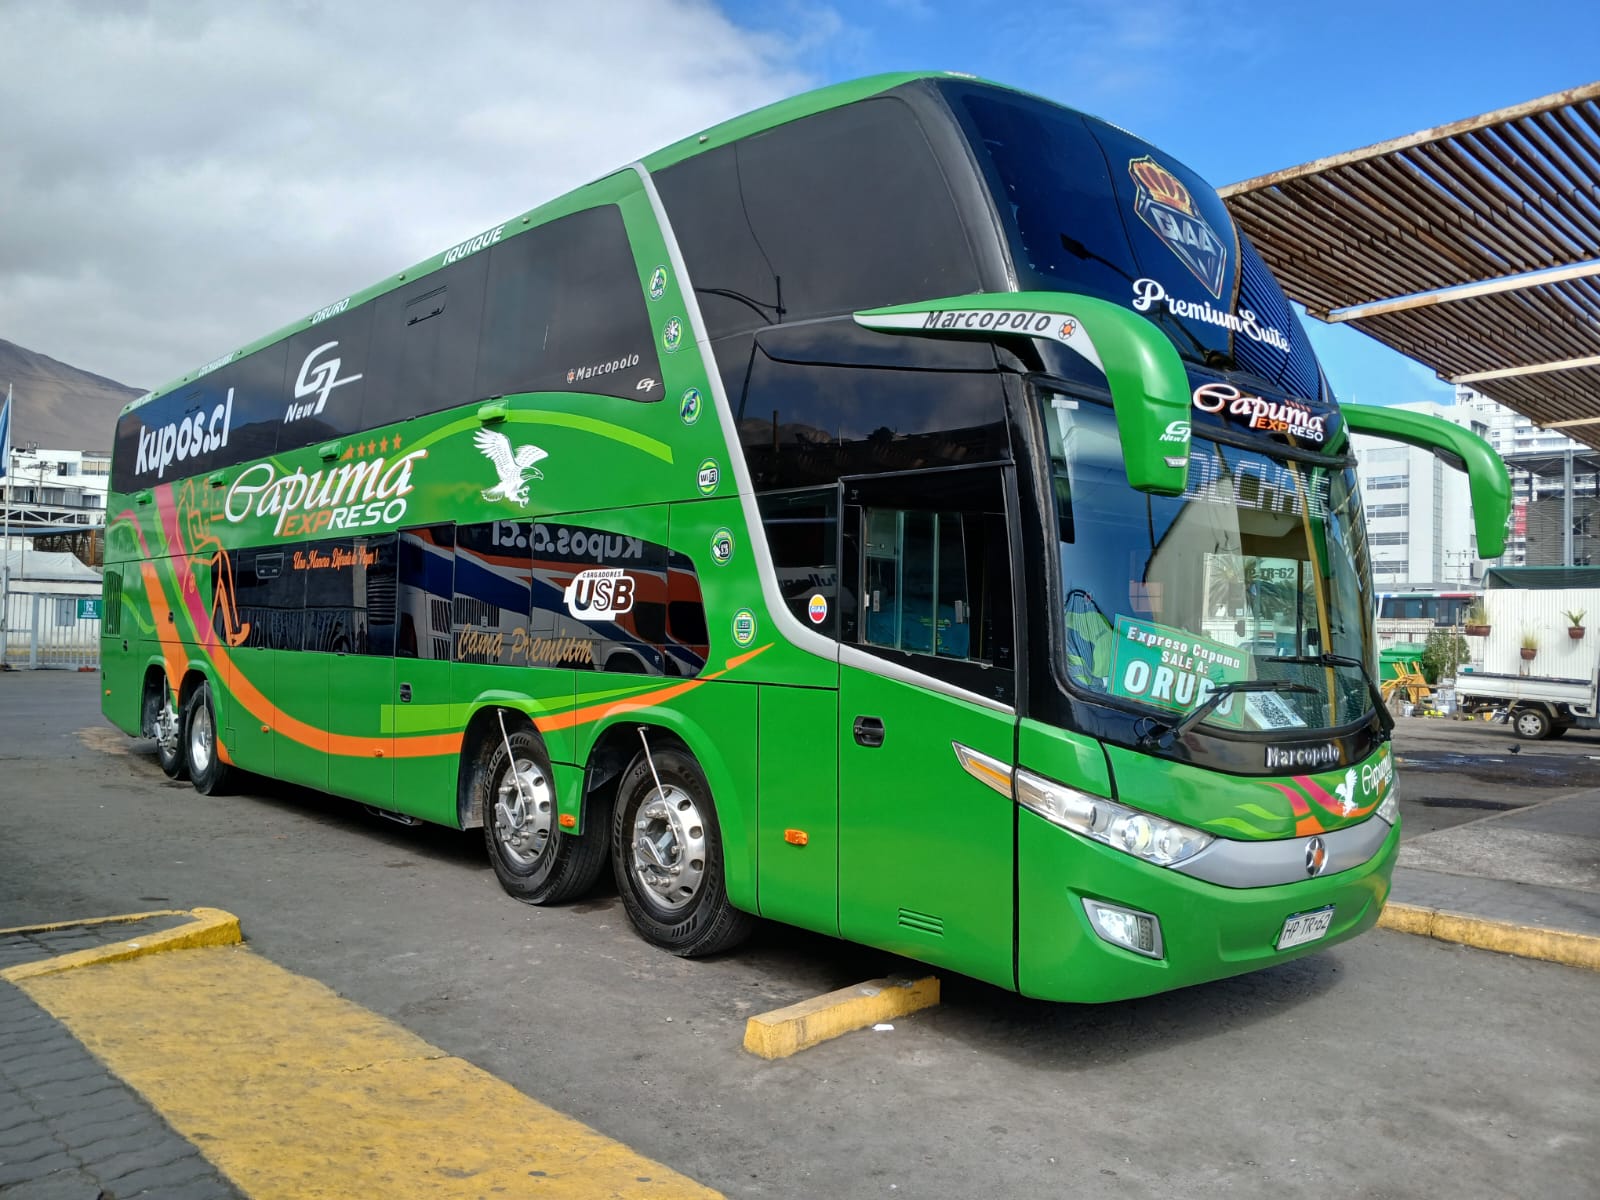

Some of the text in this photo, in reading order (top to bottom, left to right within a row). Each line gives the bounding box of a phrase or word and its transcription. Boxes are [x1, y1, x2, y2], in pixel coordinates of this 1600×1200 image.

[442, 224, 506, 266] IQUIQUE
[312, 298, 350, 325] ORURO
[923, 311, 1051, 332] Marcopolo
[1132, 278, 1290, 353] Premium Suite
[576, 354, 640, 381] Marcopolo
[284, 402, 316, 424] New
[1193, 383, 1325, 432] Capuma
[135, 387, 234, 479] kupos.cl
[1256, 418, 1324, 442] EXPRESO
[225, 449, 428, 537] Capuma
[283, 498, 408, 537] EXPRESO
[574, 578, 633, 611] USB
[458, 623, 593, 664] Cama Premium
[1127, 626, 1241, 669] Expreso Capuma
[1161, 651, 1193, 670] SALE
[1267, 743, 1341, 768] Marcopolo
